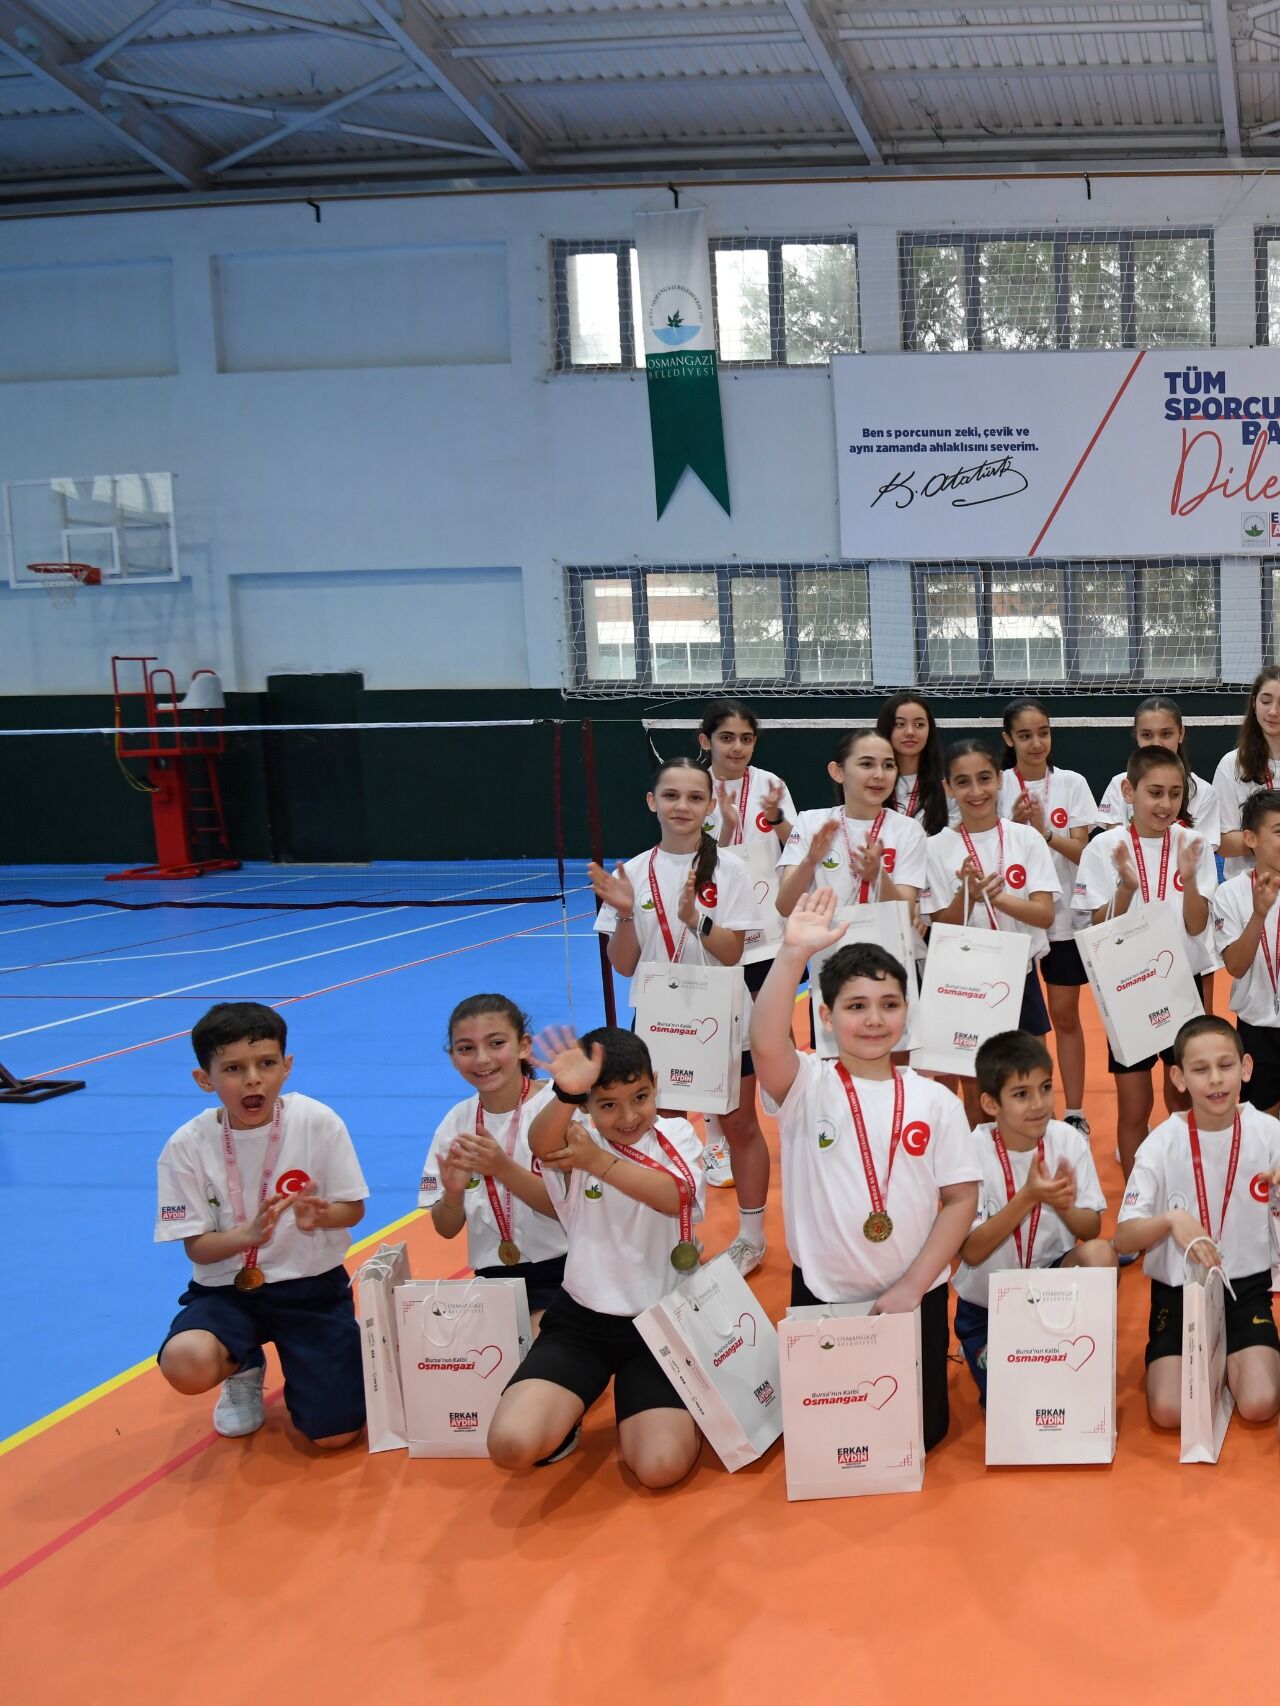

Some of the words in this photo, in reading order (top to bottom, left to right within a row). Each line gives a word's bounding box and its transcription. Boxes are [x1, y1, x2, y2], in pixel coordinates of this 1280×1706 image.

[1164, 366, 1225, 394] TÜM
[862, 428, 884, 438] Ben
[955, 427, 981, 438] zeki,
[983, 427, 1013, 438] çevik
[1016, 428, 1029, 437] ve
[850, 444, 873, 454] aynı
[876, 443, 927, 452] zamanda
[930, 442, 988, 452] ahlaklısını
[990, 441, 1039, 451] severim.
[1117, 968, 1156, 992] Osmangazi
[937, 987, 987, 999] Osmangazi
[650, 1026, 697, 1036] Osmangazi
[713, 1336, 744, 1368] Osmangazi
[1007, 1352, 1067, 1363] Osmangazi
[418, 1361, 475, 1371] Osmangazi
[754, 1379, 770, 1398] ERKAN
[812, 1390, 842, 1398] Bursa'nın
[759, 1387, 774, 1404] AYDIN
[803, 1393, 867, 1406] Osmangazi
[1036, 1409, 1065, 1417] ERKAN
[1037, 1417, 1064, 1425] AYDIN
[838, 1446, 868, 1455] ERKAN
[839, 1454, 868, 1463] AYDIN
